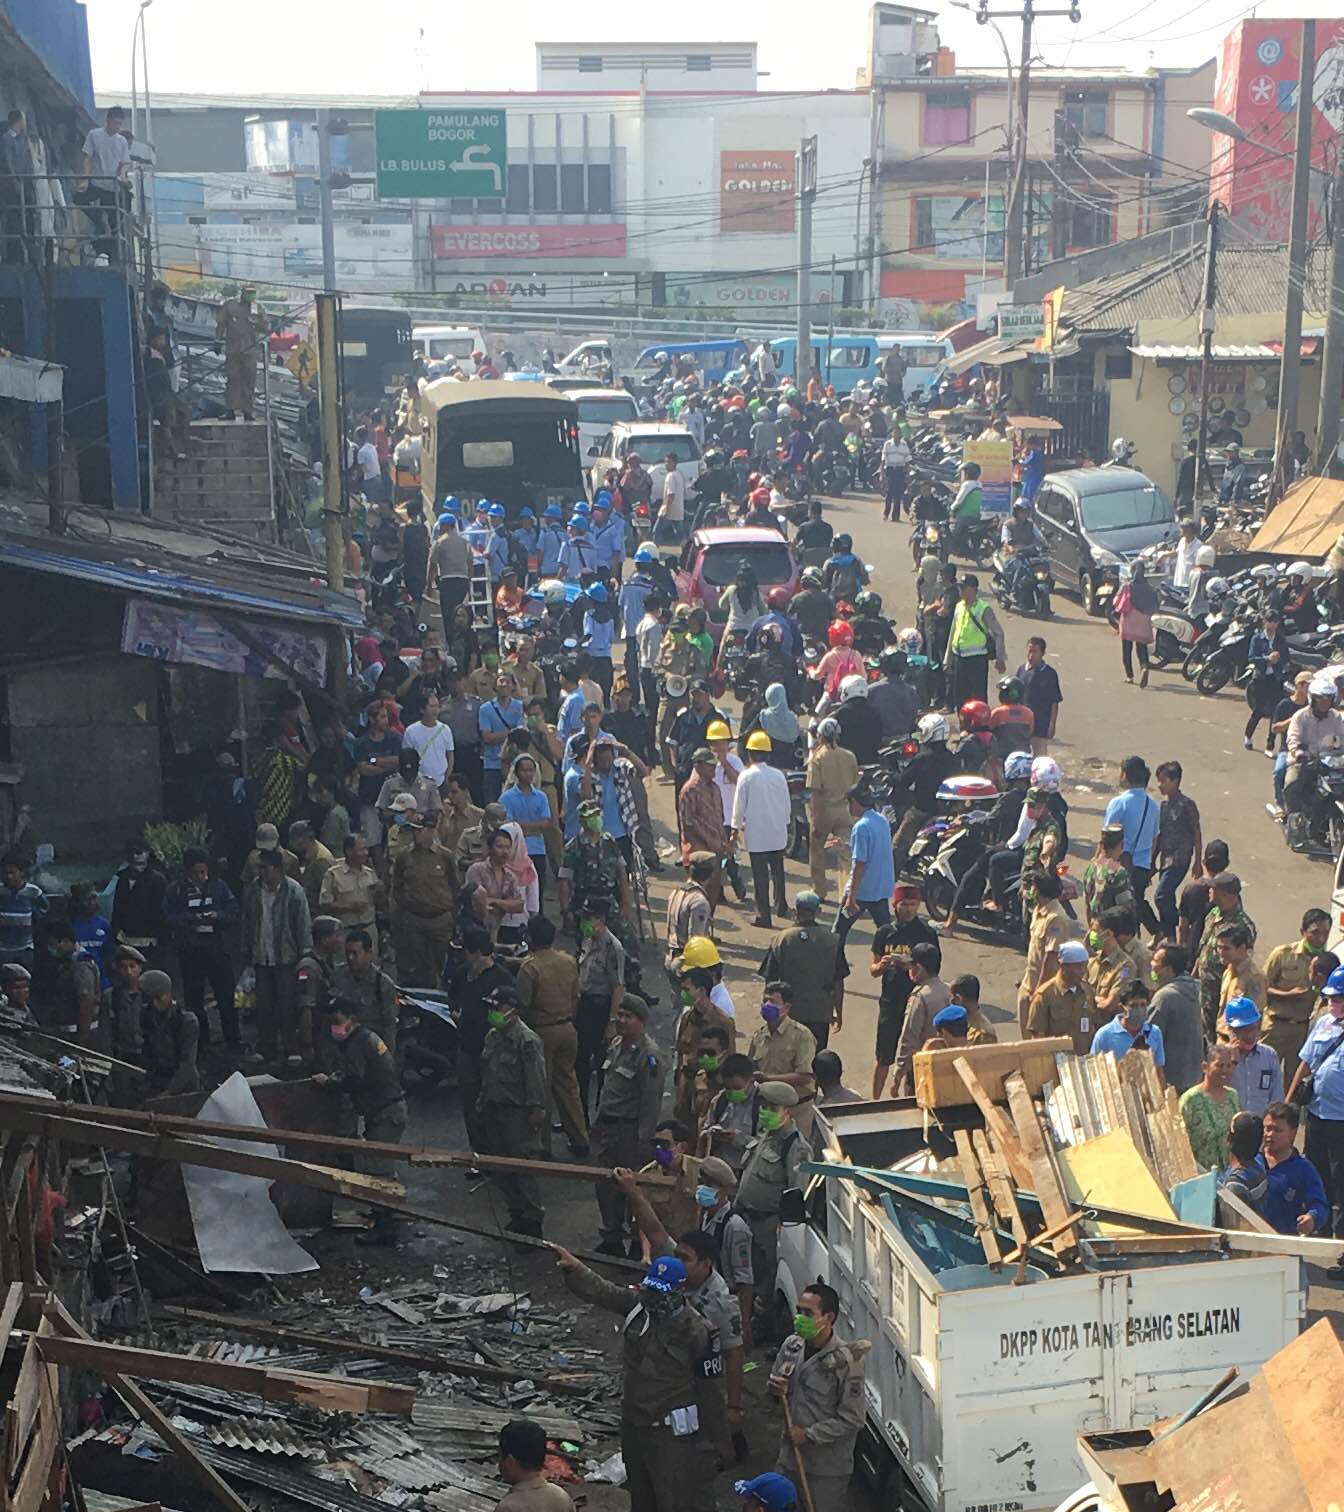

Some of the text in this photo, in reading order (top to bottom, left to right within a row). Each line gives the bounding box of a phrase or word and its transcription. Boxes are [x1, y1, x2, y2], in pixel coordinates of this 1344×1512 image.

[428, 115, 499, 127] PAMULANG
[428, 129, 475, 140] BOGOR
[725, 179, 794, 192] GOLDEN
[444, 232, 540, 250] EVERCOSS
[456, 279, 546, 297] ADVAN
[717, 288, 790, 301] GOLDEN
[999, 1330, 1038, 1359] DKPP
[1042, 1325, 1080, 1353] KOTA
[1177, 1307, 1241, 1338] SELATAN
